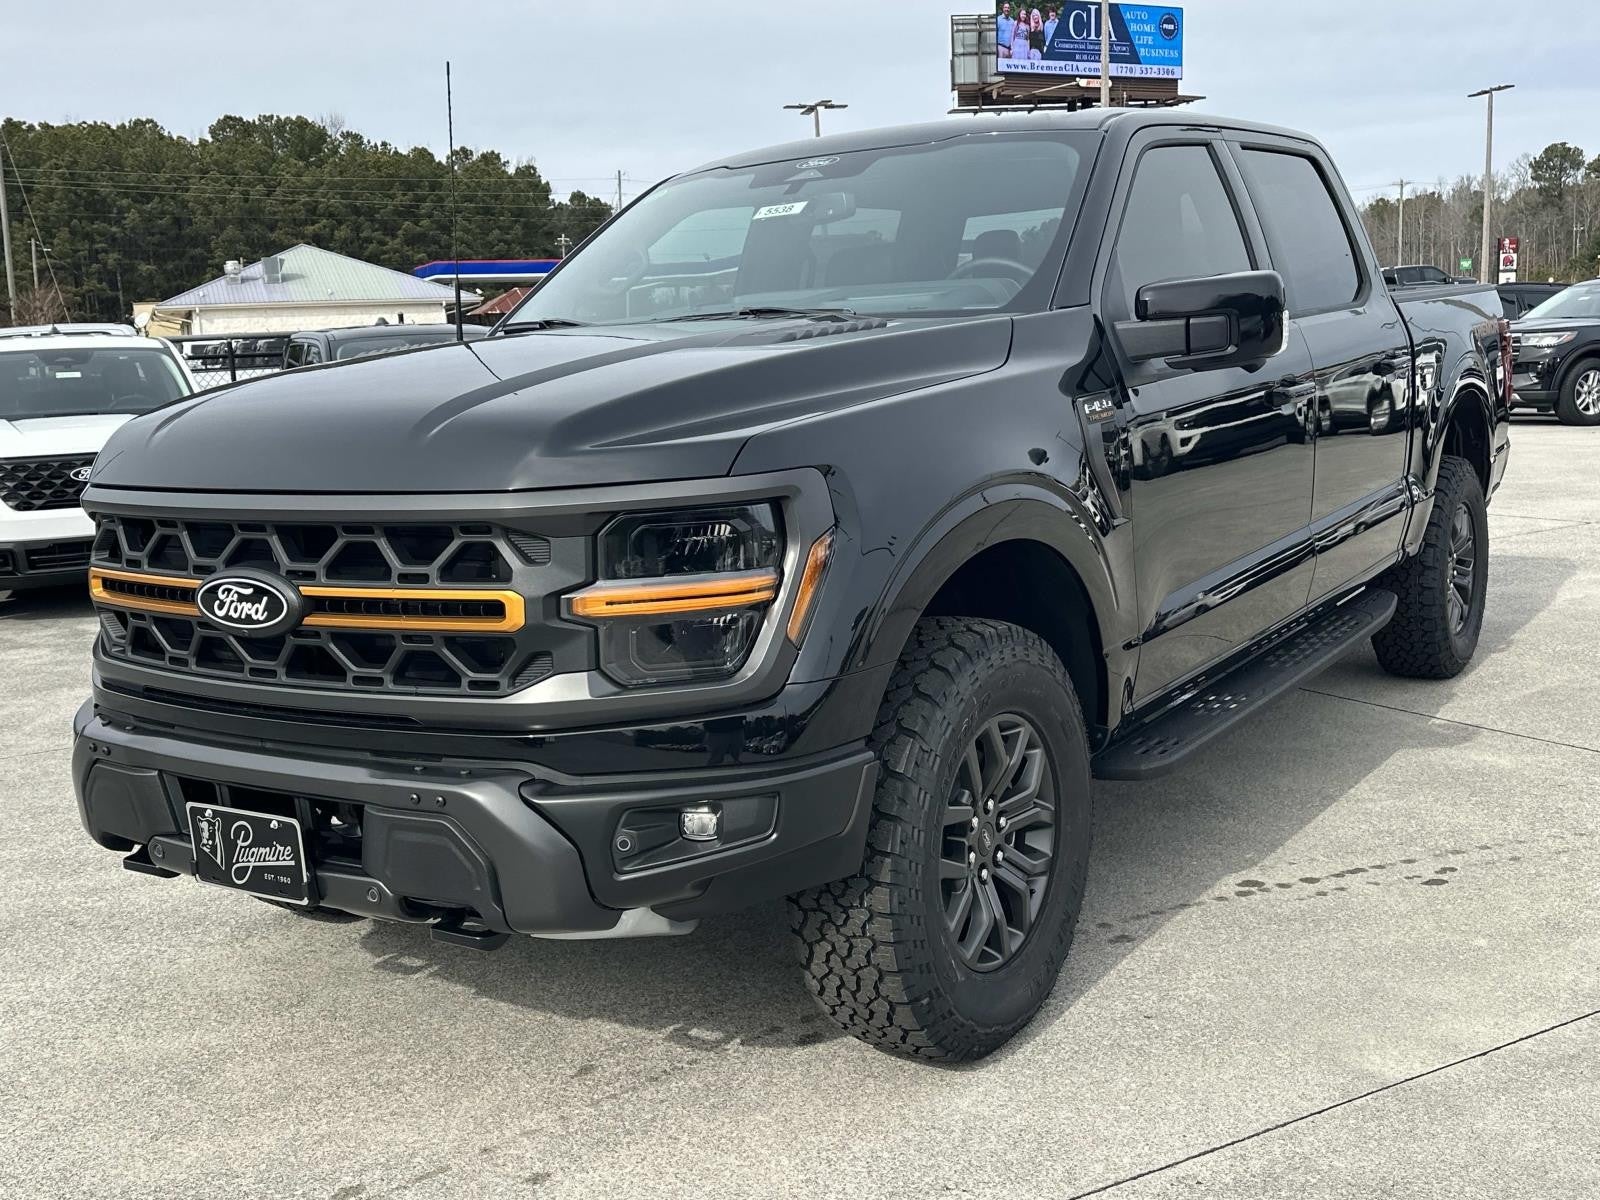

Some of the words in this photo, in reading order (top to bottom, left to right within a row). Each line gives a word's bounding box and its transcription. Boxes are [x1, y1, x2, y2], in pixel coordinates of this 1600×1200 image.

[1125, 11, 1148, 20] AUTO
[1130, 23, 1156, 33] HOME
[1135, 36, 1154, 45] LIFE
[1054, 40, 1086, 50] Commercial
[1112, 44, 1130, 53] Agency
[1140, 48, 1179, 58] BUSINESS
[1005, 62, 1101, 74] www.BremenCIA.com
[1116, 66, 1137, 75] (770)
[1139, 66, 1176, 76] 537-3306
[214, 584, 268, 620] Ford
[230, 820, 295, 885] Pugmire
[264, 873, 276, 881] EST.
